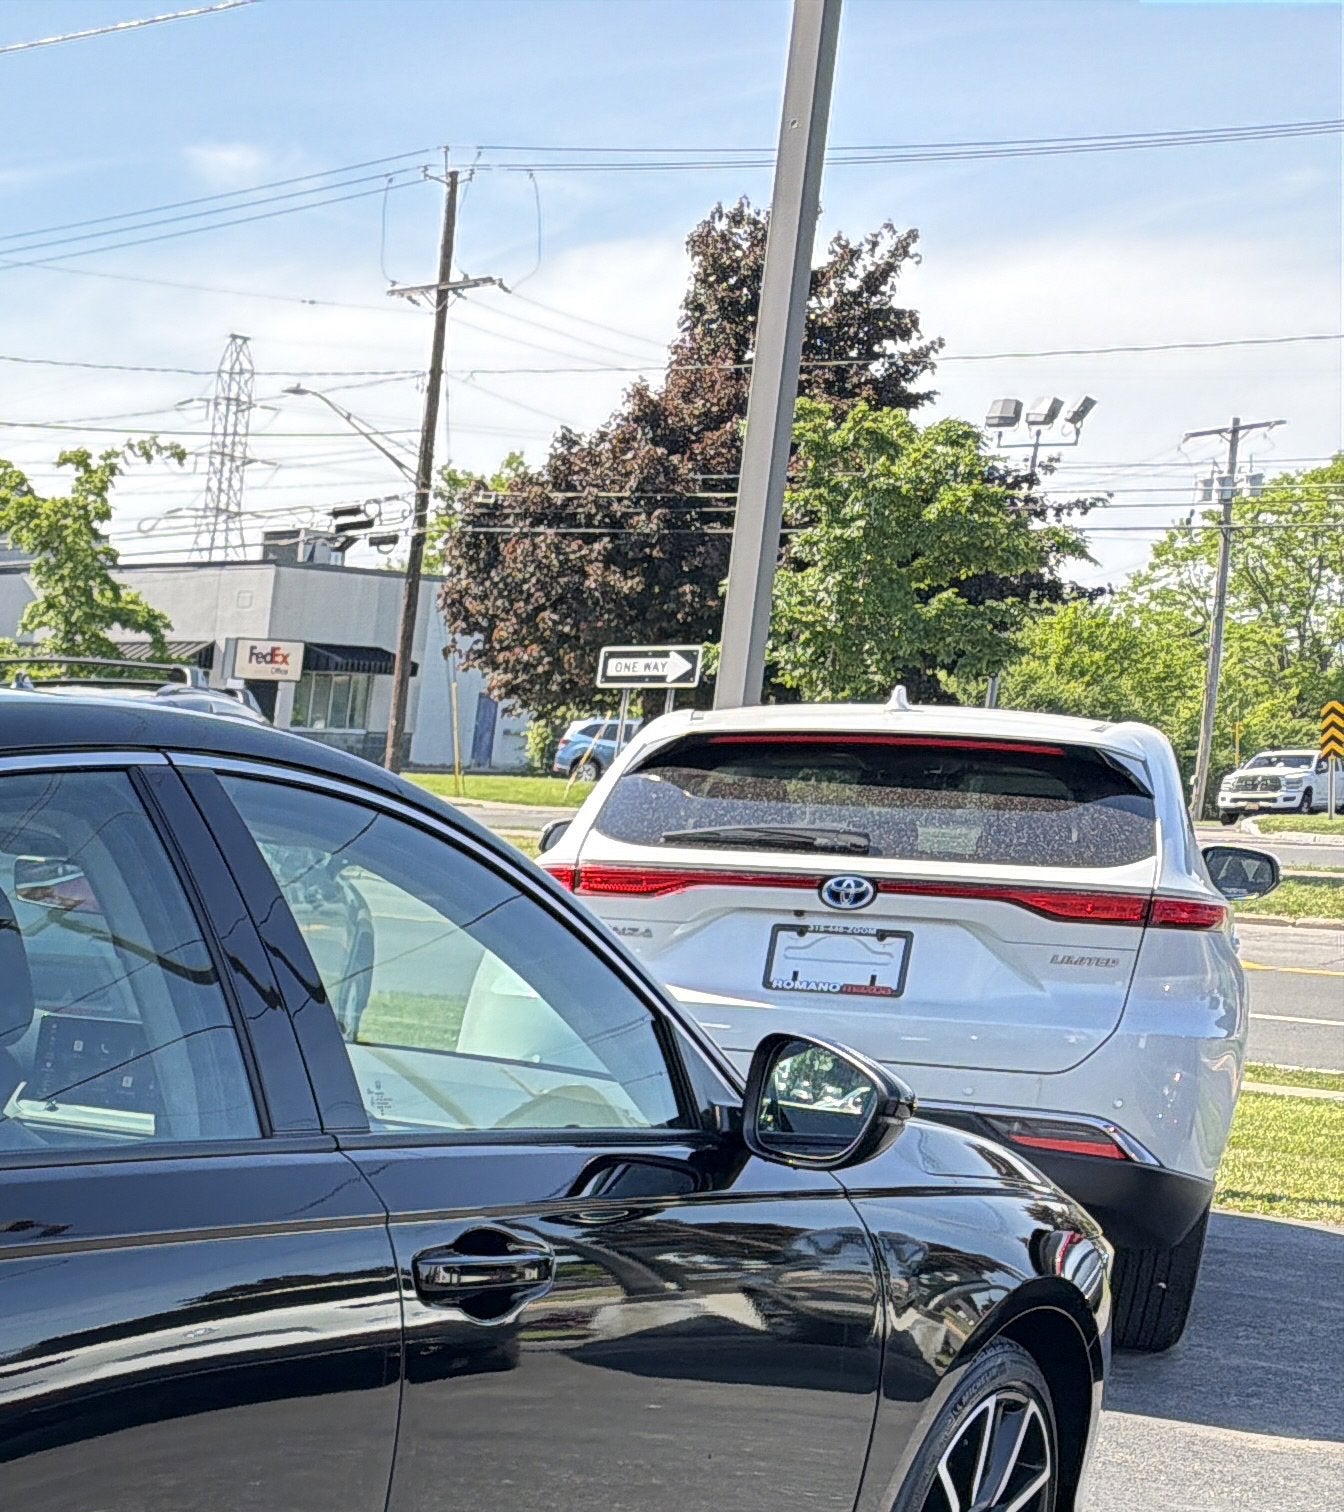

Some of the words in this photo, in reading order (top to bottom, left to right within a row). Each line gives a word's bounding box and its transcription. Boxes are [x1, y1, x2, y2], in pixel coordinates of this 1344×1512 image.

[248, 645, 290, 665] FedEx
[615, 661, 639, 673] ONE
[643, 661, 668, 673] WAY
[772, 978, 841, 992] ROMANO
